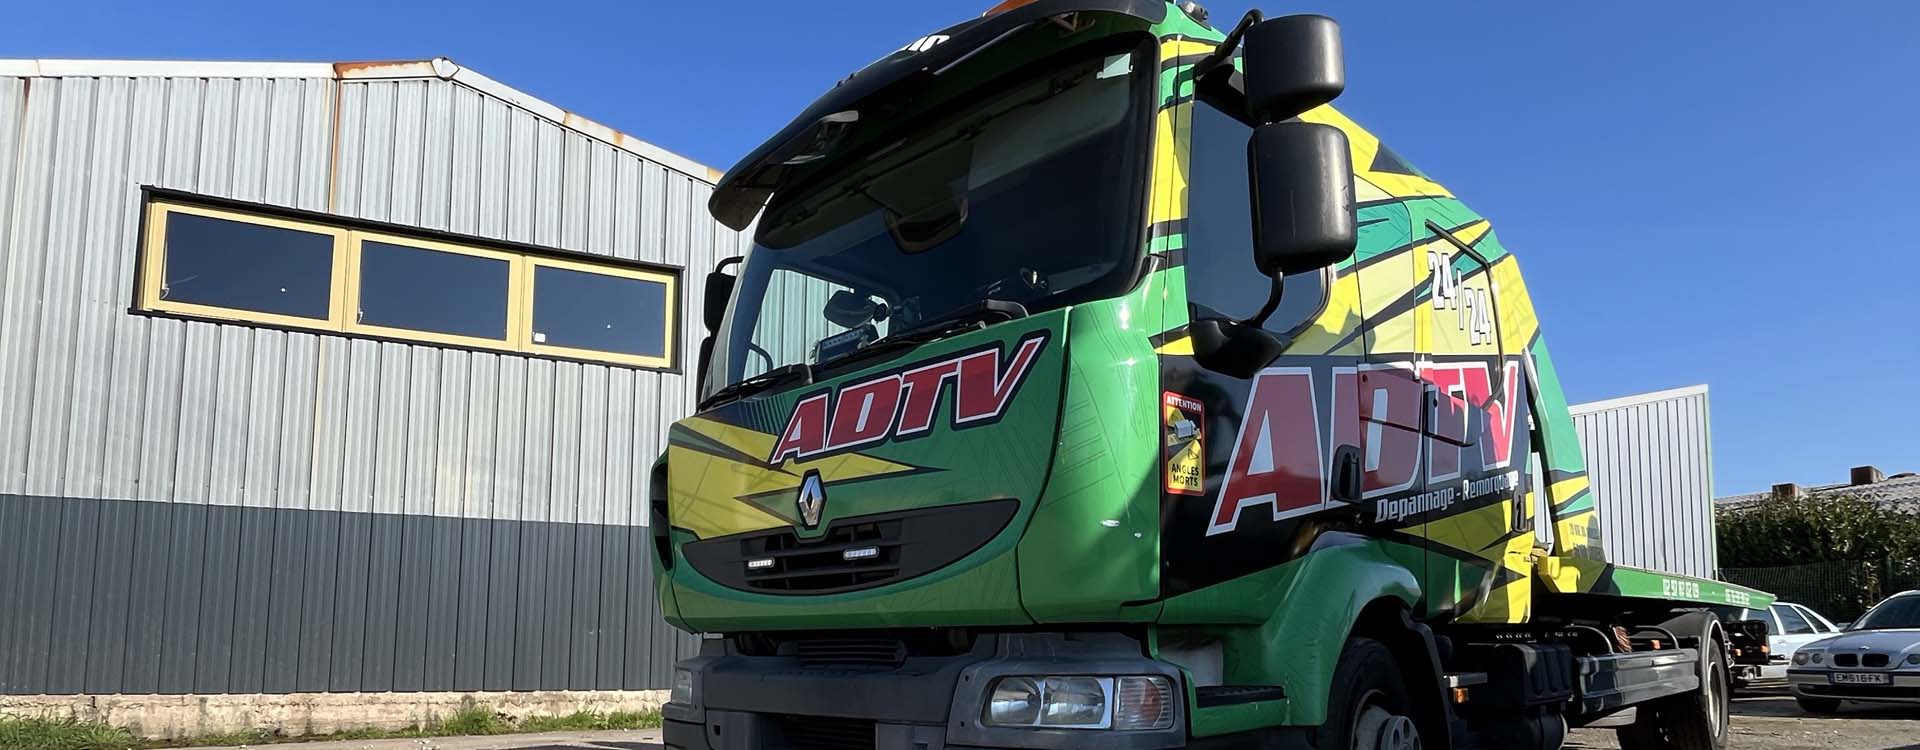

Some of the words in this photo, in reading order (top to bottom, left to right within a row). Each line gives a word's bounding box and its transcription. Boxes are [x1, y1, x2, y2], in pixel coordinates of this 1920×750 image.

[771, 336, 1045, 465] ADTV
[1167, 395, 1202, 412] ATTENTION
[1206, 361, 1518, 536] ADTV
[1171, 463, 1200, 476] ANGLES
[1172, 474, 1199, 487] MORTS
[1375, 487, 1455, 523] Depannage
[1463, 470, 1519, 501] Remorquage
